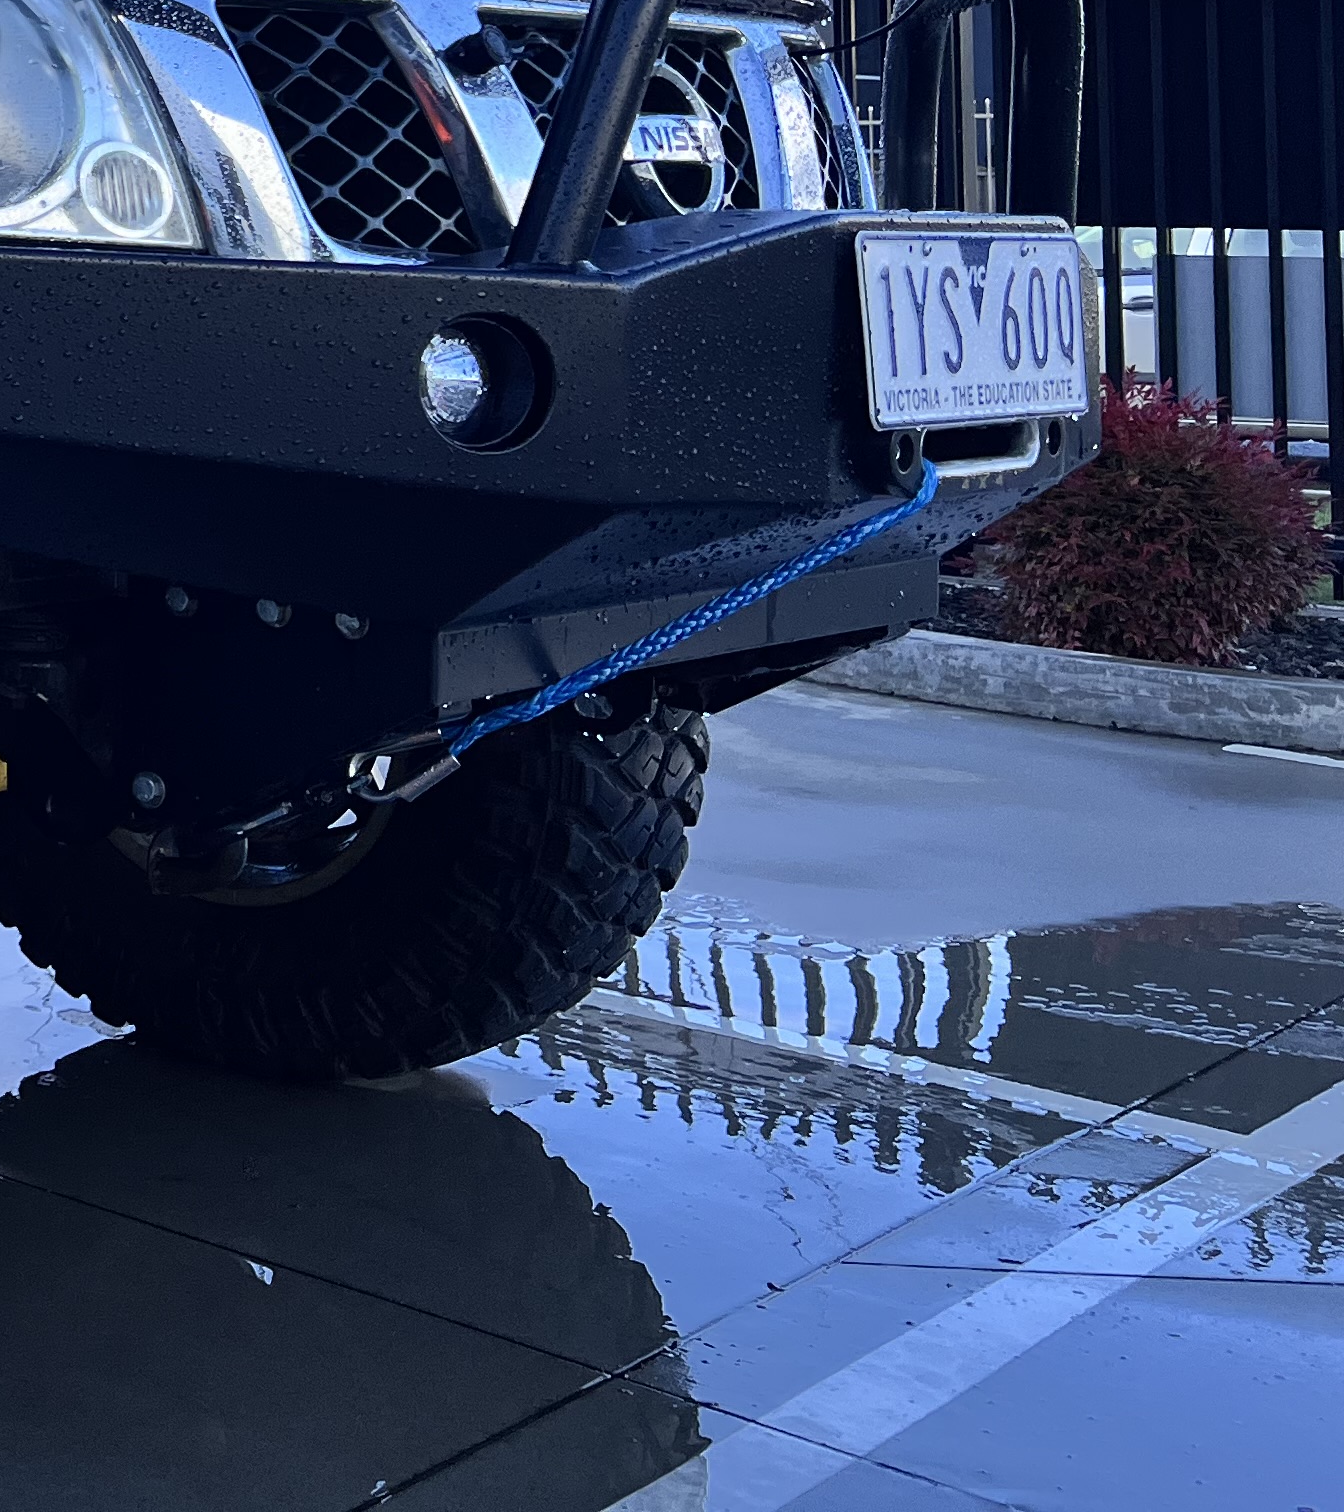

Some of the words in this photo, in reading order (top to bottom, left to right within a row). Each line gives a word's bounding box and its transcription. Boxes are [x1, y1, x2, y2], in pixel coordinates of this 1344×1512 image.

[880, 265, 962, 377] 1YS
[884, 388, 941, 413] VICTORIA
[951, 384, 974, 408] THE
[977, 380, 1039, 405] EDUCATION
[1043, 379, 1073, 401] STATE
